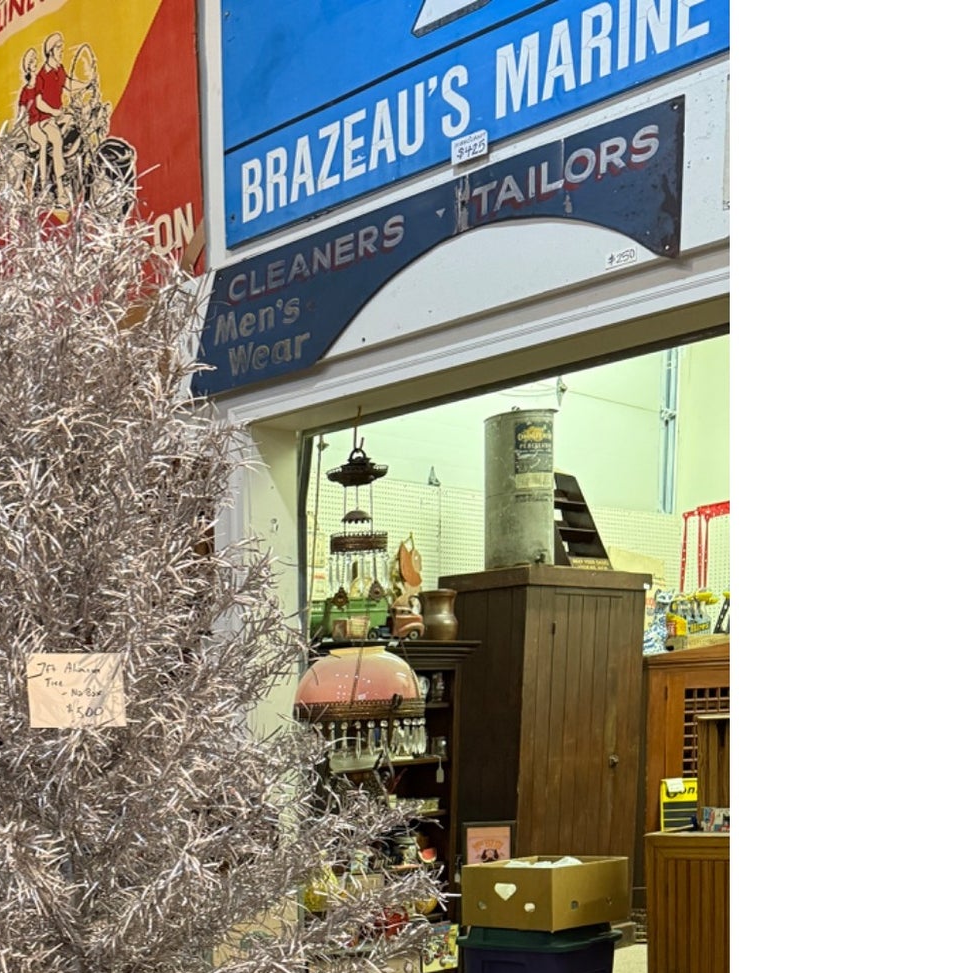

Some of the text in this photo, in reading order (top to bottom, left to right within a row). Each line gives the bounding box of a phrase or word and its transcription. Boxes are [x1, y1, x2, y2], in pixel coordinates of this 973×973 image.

[240, 0, 710, 224] BRAZEAU'S MARINE
[457, 138, 486, 160] $425
[228, 124, 661, 301] CLEANERS TAILORS
[608, 248, 635, 266] $250
[214, 298, 301, 346] Men's
[228, 331, 311, 377] Wear
[66, 703, 104, 719] $500
